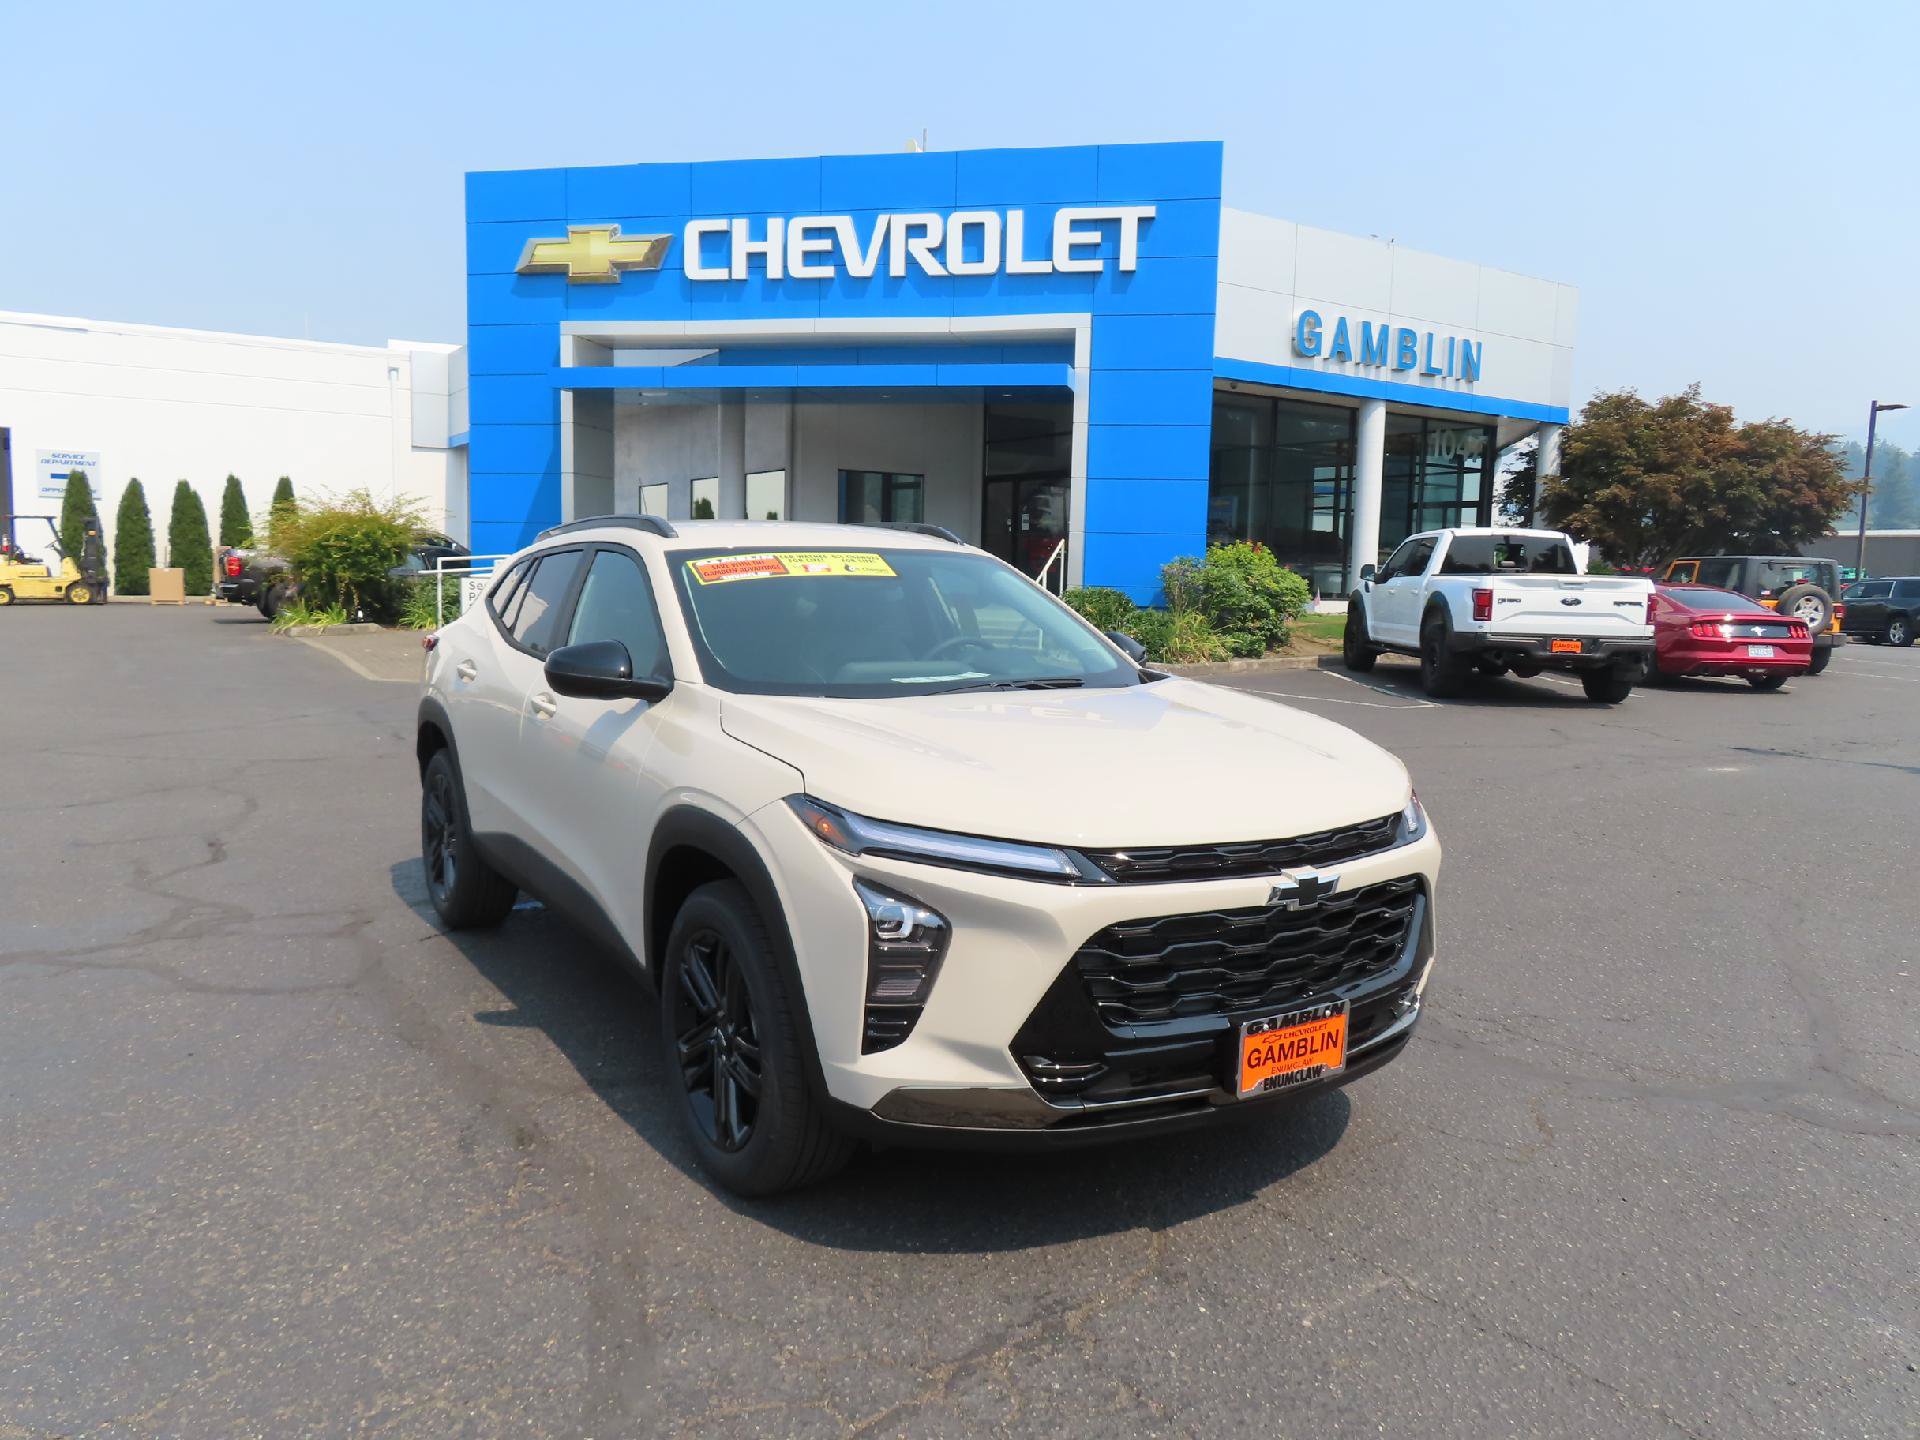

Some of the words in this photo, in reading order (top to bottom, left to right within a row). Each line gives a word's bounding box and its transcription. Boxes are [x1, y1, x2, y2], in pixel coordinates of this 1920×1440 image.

[683, 205, 1156, 281] CHEVROLET
[1293, 310, 1482, 382] GAMBLIN
[1282, 1023, 1328, 1038] CHEVROLET
[1247, 1030, 1340, 1068] GAMBLIN
[1263, 1064, 1323, 1091] ENUMCLAW
[1271, 1058, 1312, 1074] ENUMCLAW
